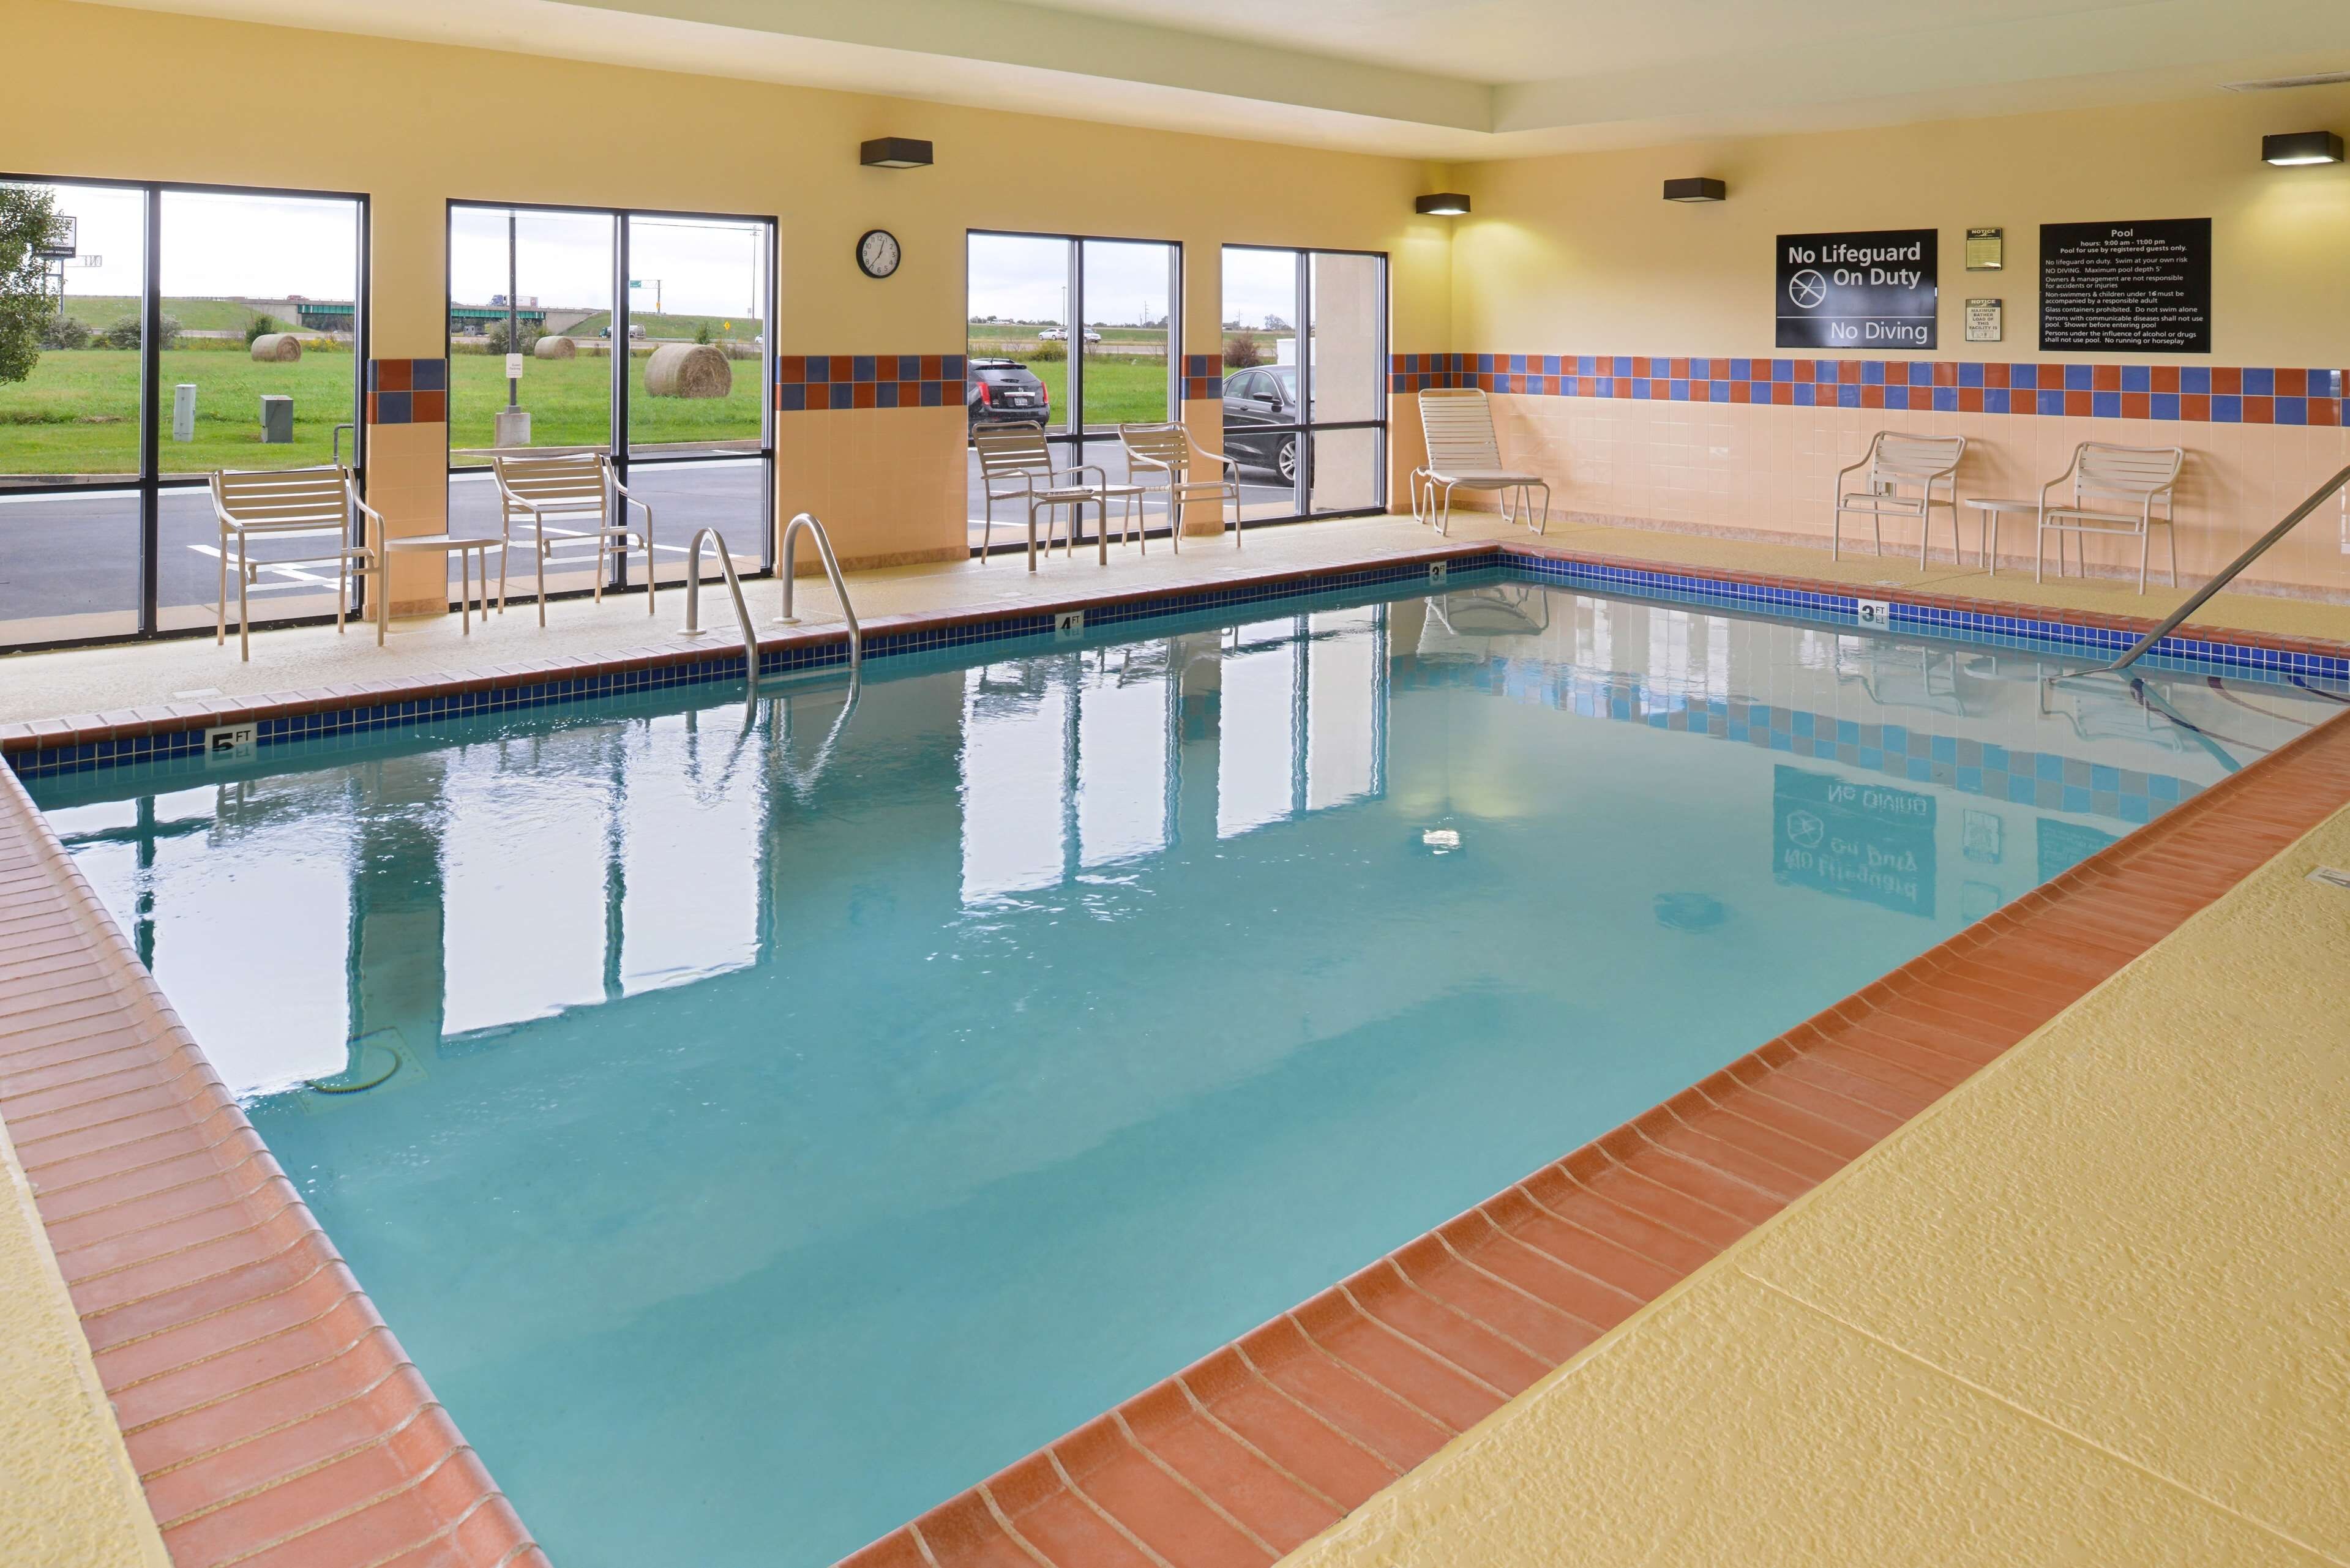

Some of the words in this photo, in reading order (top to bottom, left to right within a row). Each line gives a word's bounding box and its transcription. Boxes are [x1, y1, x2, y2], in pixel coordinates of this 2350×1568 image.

[2111, 229, 2133, 237] Pool
[1789, 247, 1815, 263] No
[1822, 242, 1920, 266] Lifeguard
[1833, 269, 1862, 286] On
[1871, 269, 1921, 289] Duty
[1832, 322, 1857, 339] No
[1866, 321, 1927, 344] Diving
[1862, 605, 1874, 616] 3
[1060, 617, 1070, 629] 4
[212, 733, 234, 752] 5
[236, 731, 251, 742] FT
